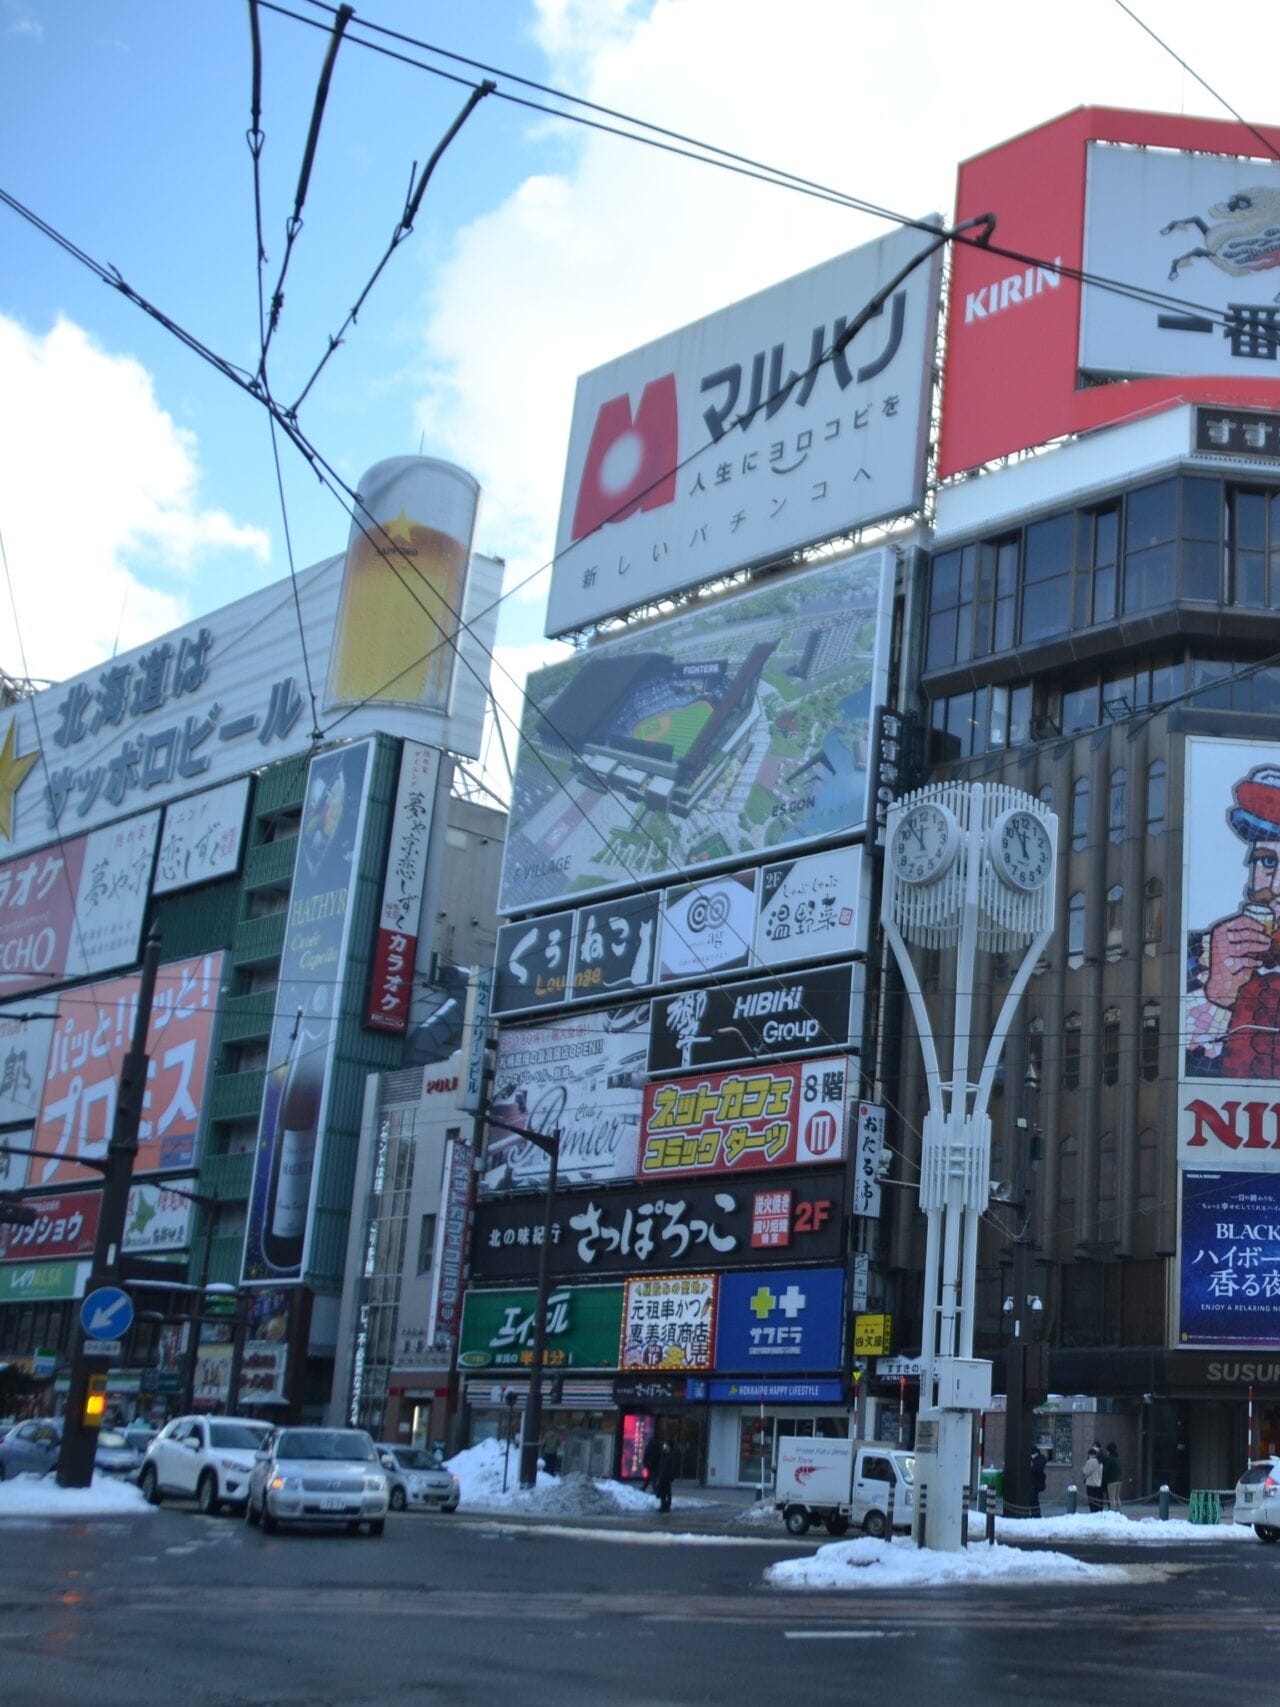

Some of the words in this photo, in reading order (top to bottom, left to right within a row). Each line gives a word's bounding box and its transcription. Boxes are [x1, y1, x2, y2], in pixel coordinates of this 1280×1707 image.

[964, 256, 1062, 325] KIRIN
[700, 289, 907, 444] マルハン
[689, 395, 900, 497] 人生にヨロコビを
[582, 467, 871, 589] 新しいパチンコへ
[54, 628, 213, 747] 北海道は
[43, 677, 305, 829] サッポロビール
[523, 855, 572, 880] VILLAGE
[765, 871, 782, 889] 2F
[766, 894, 838, 941] 温野菜
[381, 934, 408, 1011] カラオケ
[535, 967, 601, 996] Lounge
[733, 986, 803, 1019] HIBIKI
[763, 1018, 819, 1043] Group
[649, 1075, 793, 1131] ネットカフェ
[804, 1071, 844, 1103] 8階
[644, 1130, 721, 1171] コミック
[724, 1123, 790, 1166] ダーツ
[569, 1194, 737, 1263] さっぽろっこ
[794, 1200, 831, 1232] 2F
[489, 1292, 572, 1347] エイル
[631, 1298, 701, 1320] 元祖串かつ
[1201, 1304, 1224, 1312] ENJOY
[1235, 1304, 1270, 1313] RELAXING
[629, 1322, 708, 1343] 恵美須商店
[739, 1385, 767, 1395] HOKKAIDO
[769, 1385, 789, 1395] HAPPY
[789, 1385, 819, 1396] LIFESTYLE
